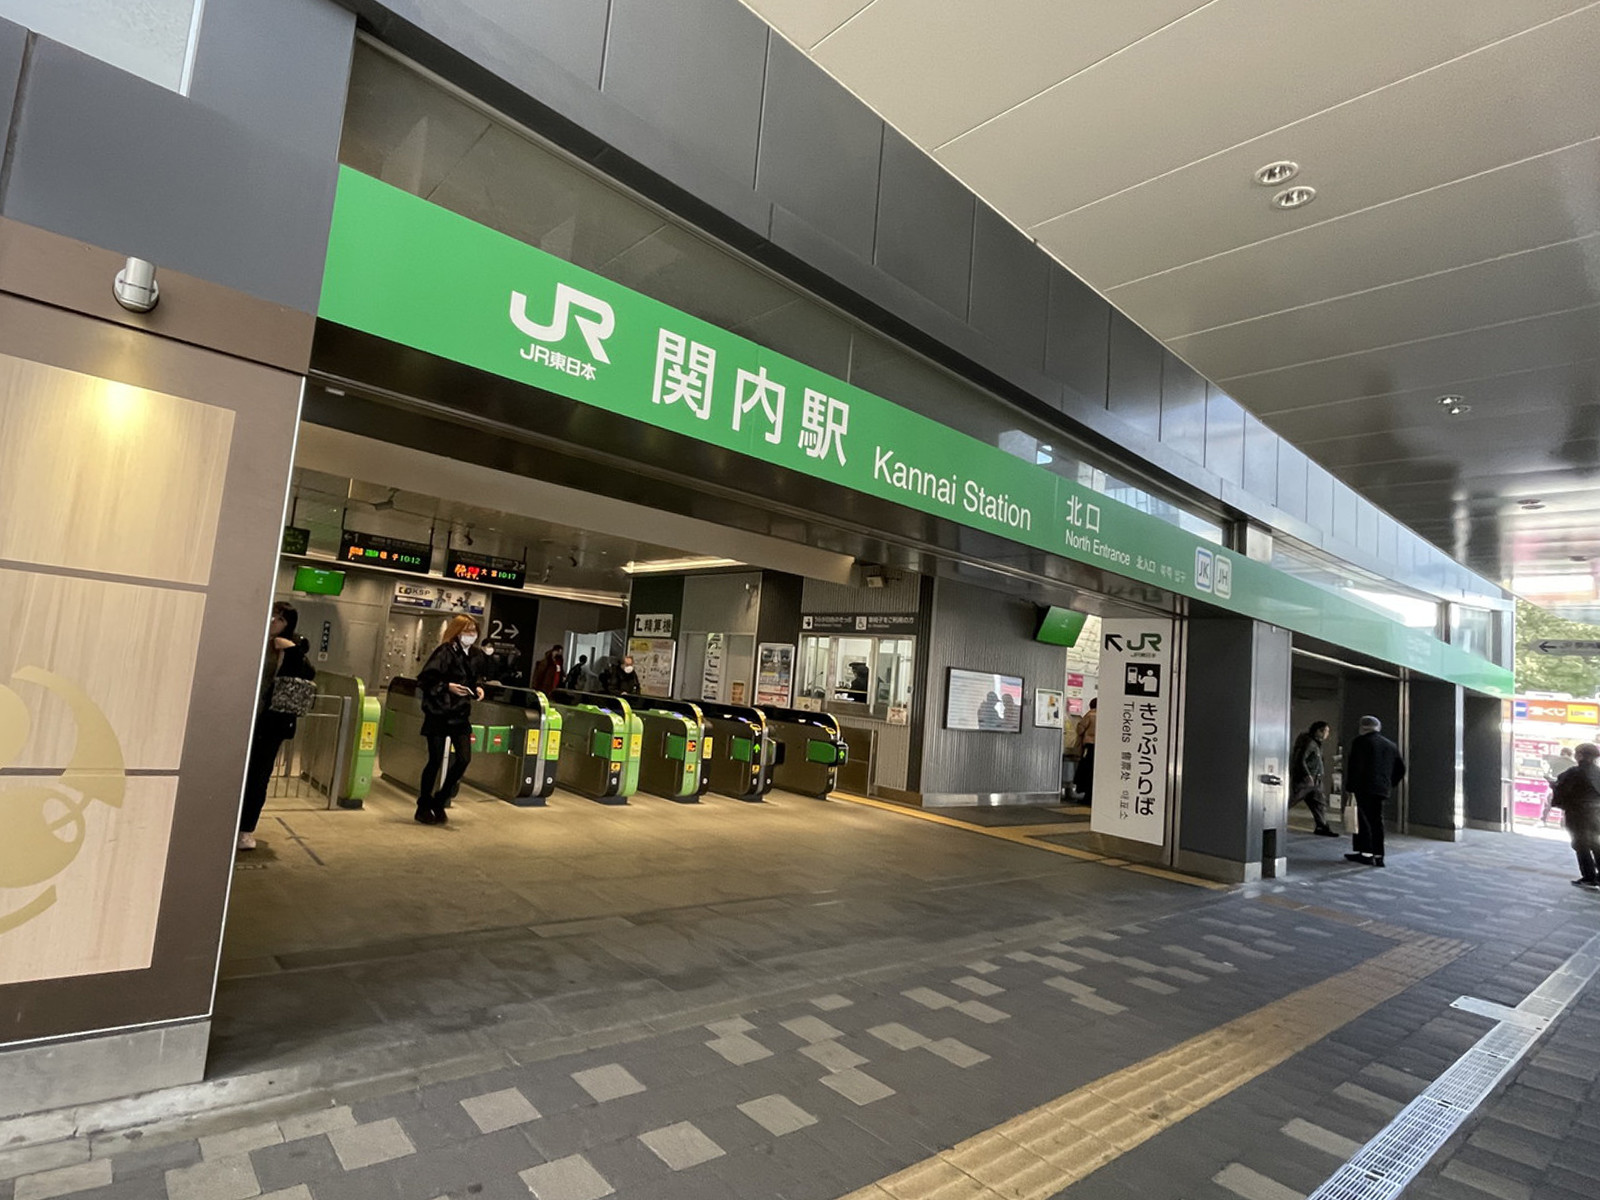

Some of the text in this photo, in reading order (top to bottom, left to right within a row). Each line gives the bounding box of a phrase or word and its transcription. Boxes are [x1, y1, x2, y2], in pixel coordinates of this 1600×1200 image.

[509, 282, 616, 365] JR
[520, 343, 597, 381] JR東日本
[652, 327, 850, 468] 関内駅
[874, 446, 1032, 531] Kannai Station
[1065, 494, 1101, 534] 北口
[400, 555, 421, 565] 10:12
[1065, 528, 1131, 566] North Entrance
[498, 571, 517, 580] 10:17
[1198, 560, 1210, 580] JK
[1218, 568, 1229, 586] JH
[490, 619, 503, 639] 2
[1126, 632, 1163, 652] JR
[1121, 701, 1135, 744] Tickets
[1135, 702, 1158, 816] きっぷうりば
